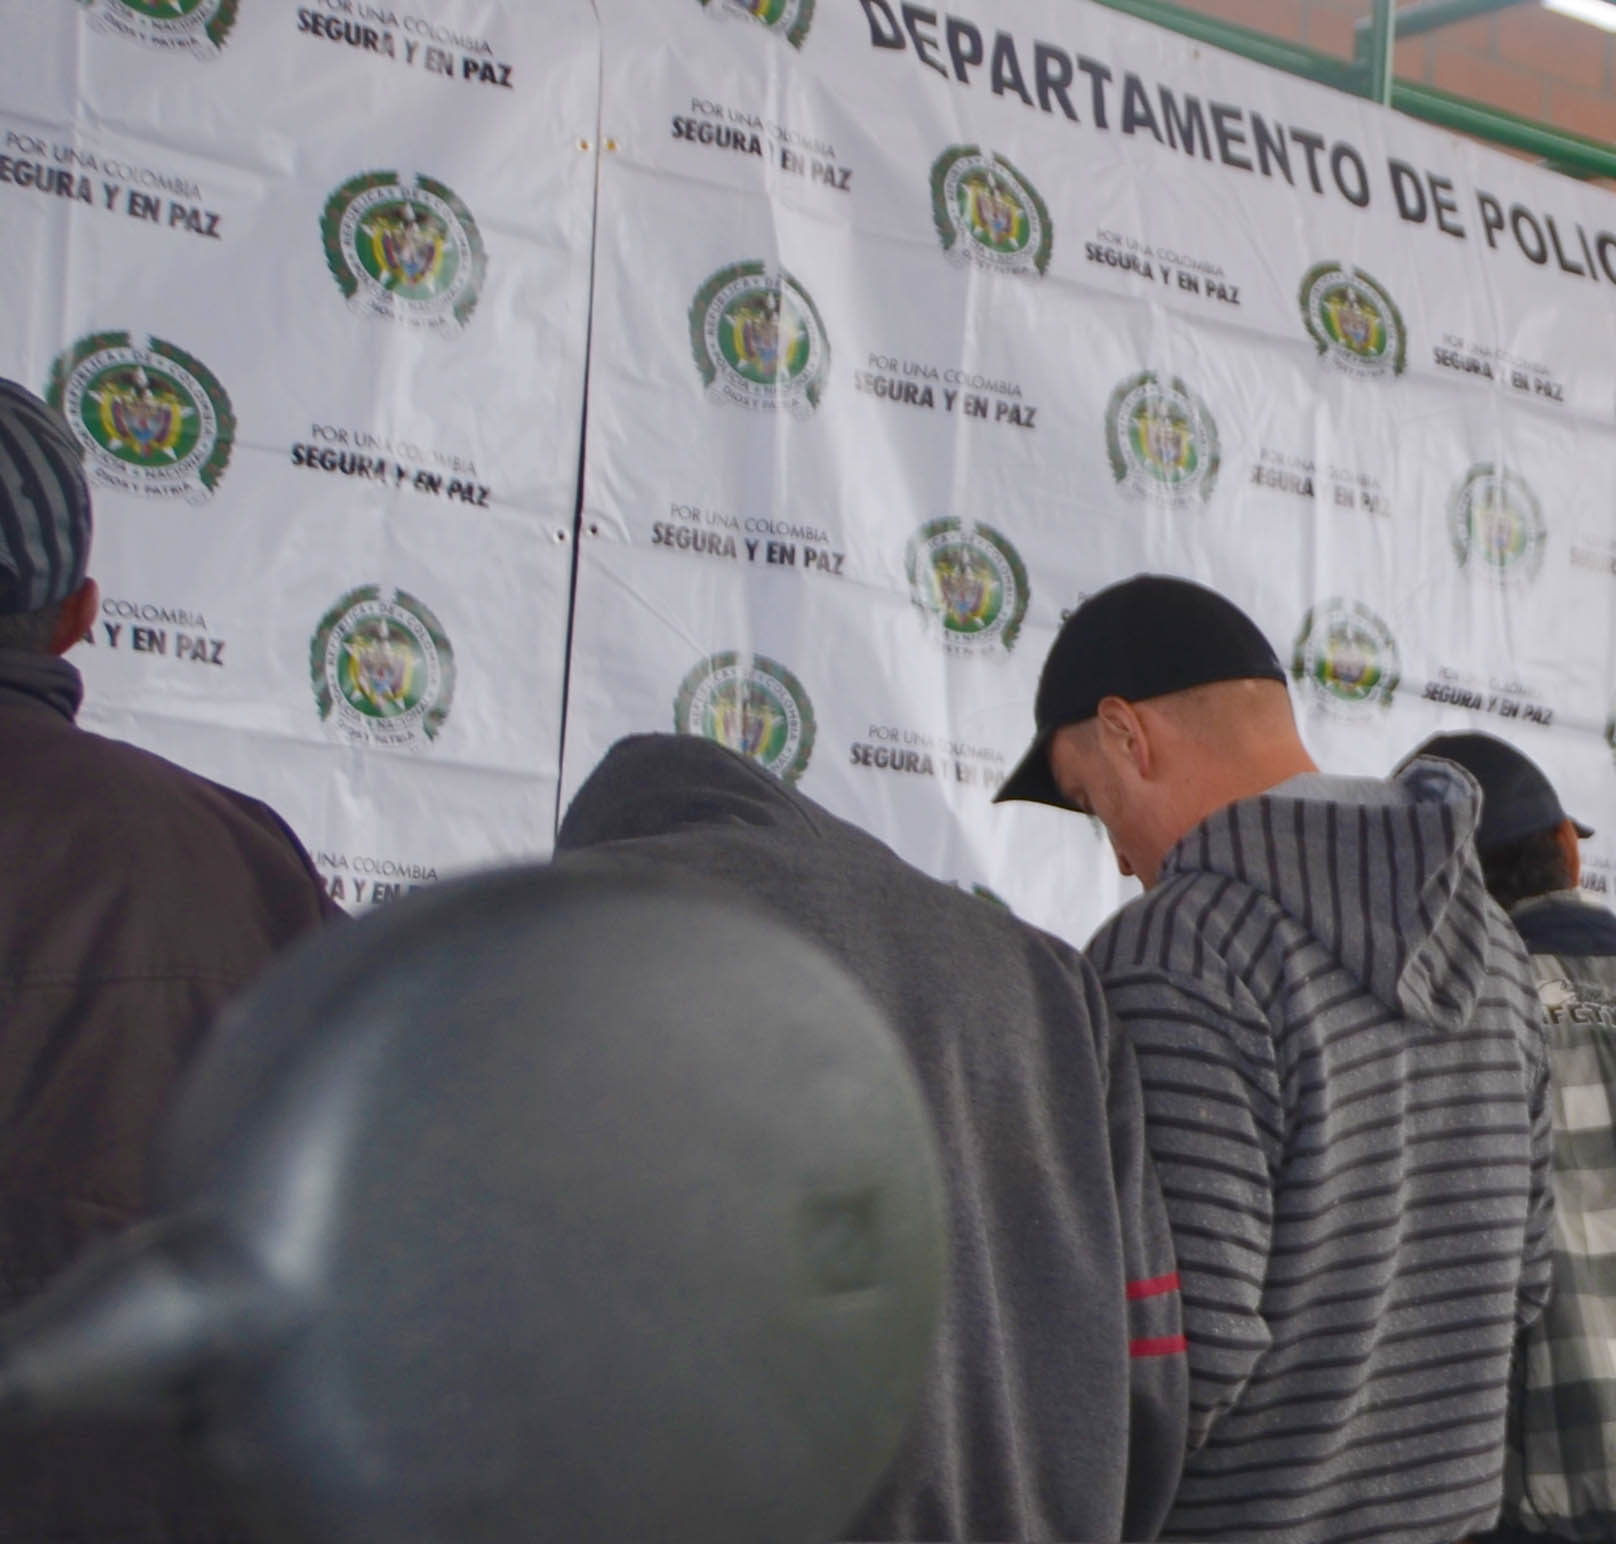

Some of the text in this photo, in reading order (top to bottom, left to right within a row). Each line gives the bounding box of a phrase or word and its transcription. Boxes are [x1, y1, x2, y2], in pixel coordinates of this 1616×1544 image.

[298, 8, 513, 89] SEGURA Y EN PAZ
[358, 6, 399, 27] UNA
[403, 16, 494, 54] COLOMBIA
[691, 98, 724, 118] POR
[727, 108, 764, 129] UNA
[861, 0, 1371, 208] DEPARTAMENTO
[1387, 157, 1466, 239] DE
[6, 131, 202, 201] POR UNA COLOMBIA
[671, 115, 854, 191] SEGURA EN PAZ
[0, 154, 221, 240] EGURA Y EN PAZ
[1084, 240, 1241, 305] SEGURA Y EN PAZ
[868, 352, 1023, 398] POR UNA COLOMBIA
[1533, 377, 1564, 402] PAZ
[854, 370, 1037, 429] SEGURA Y EN PAZ
[311, 423, 349, 447] POR
[291, 442, 388, 487] SEGURA
[413, 469, 444, 495] EN
[447, 477, 491, 508] PAZ
[670, 503, 830, 543] POR UNA COLOMBIA
[651, 521, 846, 576] SEGURA Y EN PAZ
[102, 598, 208, 630] COLOMBIA
[103, 620, 121, 648] Y
[132, 624, 166, 655] EN
[175, 632, 226, 666] PAZ
[1424, 681, 1482, 711] SEGURA
[1523, 704, 1554, 726] PAZ
[868, 724, 898, 741] POR
[850, 741, 934, 776] SEGURA
[352, 876, 366, 902] Y
[372, 880, 400, 904] EN
[353, 856, 438, 881] COLOMBIA
